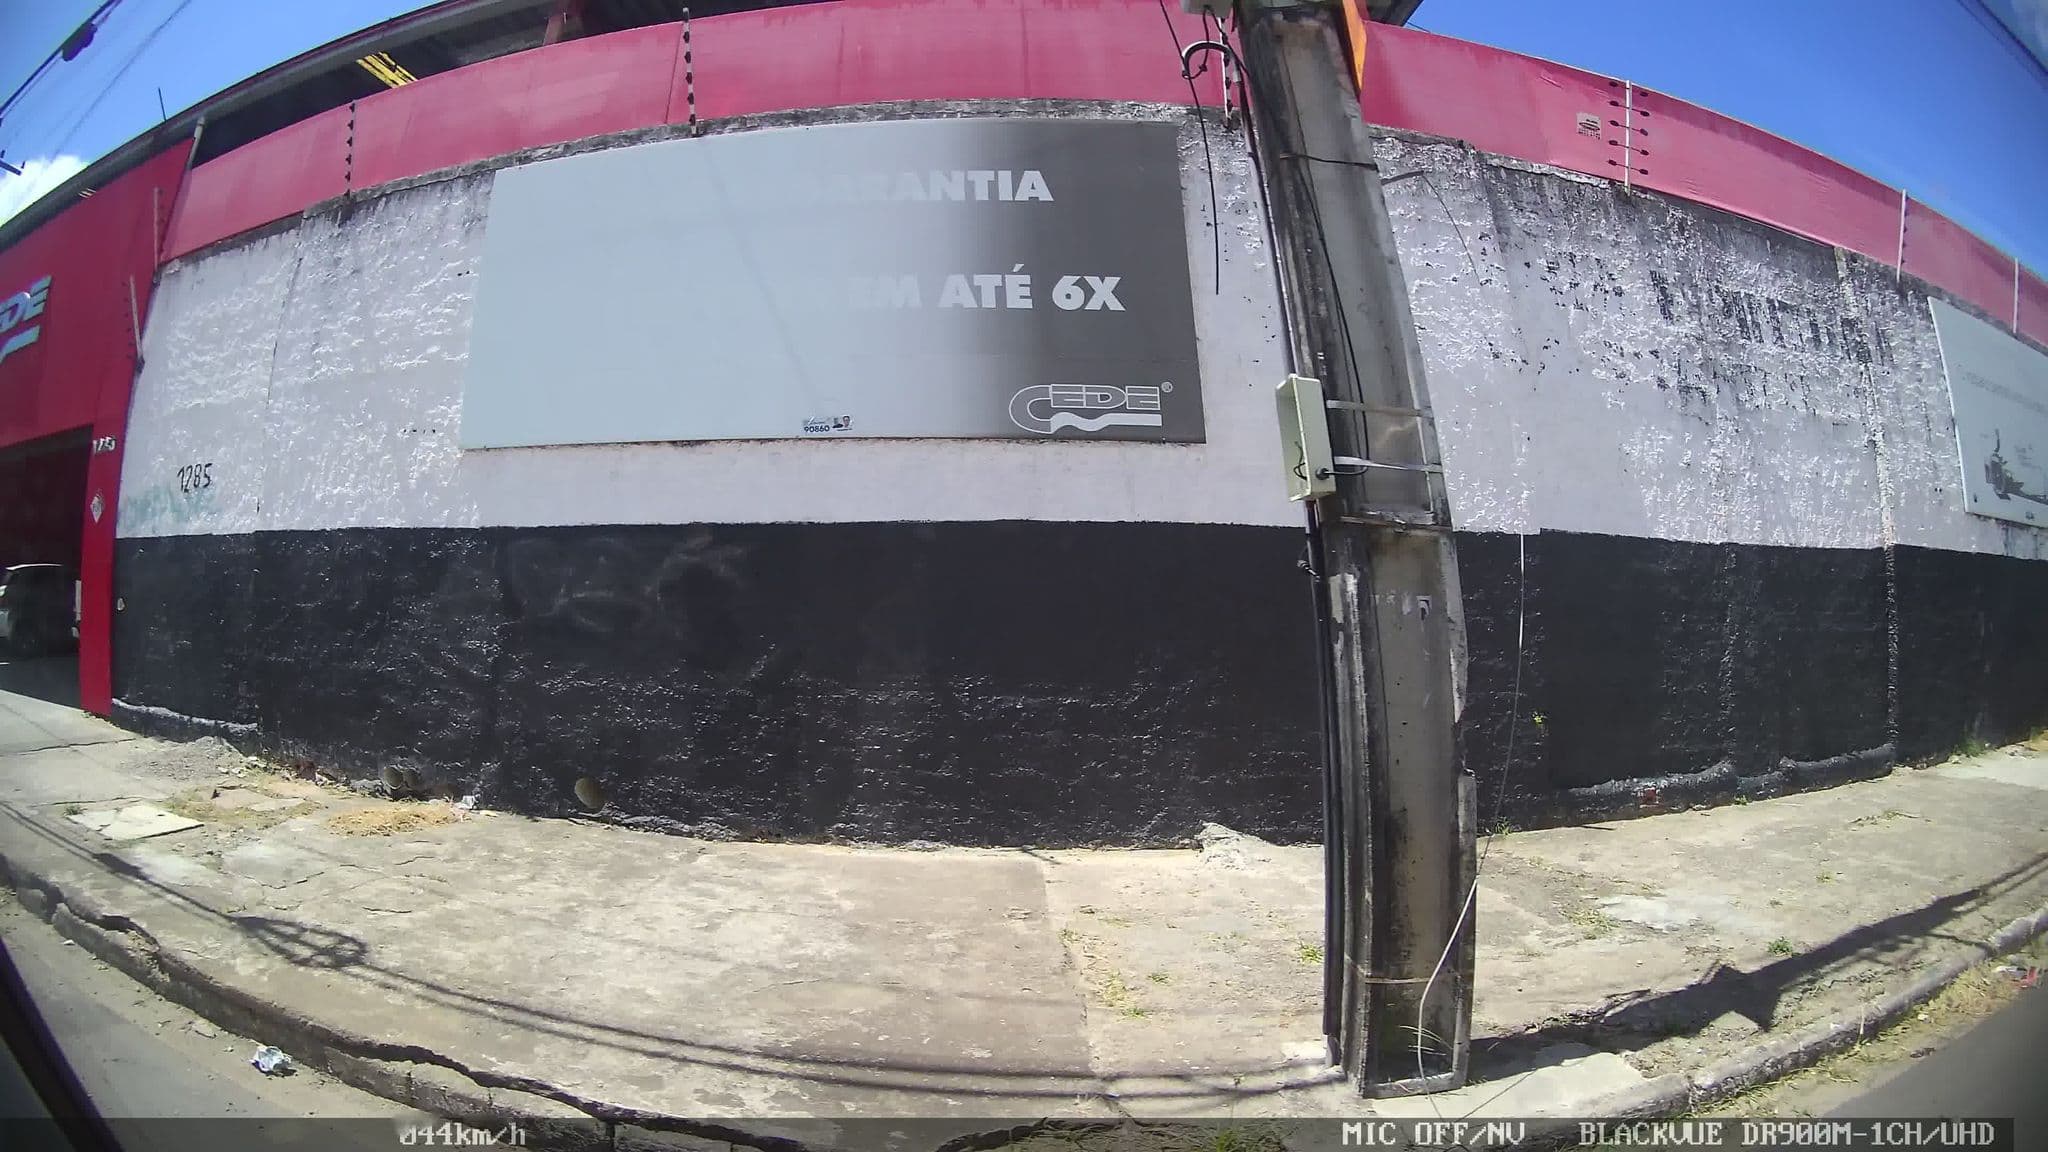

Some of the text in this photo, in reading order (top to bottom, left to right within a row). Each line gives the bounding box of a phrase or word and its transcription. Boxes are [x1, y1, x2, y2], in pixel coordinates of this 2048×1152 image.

[938, 263, 1033, 309] ATÉ
[1052, 275, 1126, 311] 6X
[803, 424, 830, 433] 90860
[1008, 384, 1161, 434] CEDE
[176, 462, 213, 493] 1285
